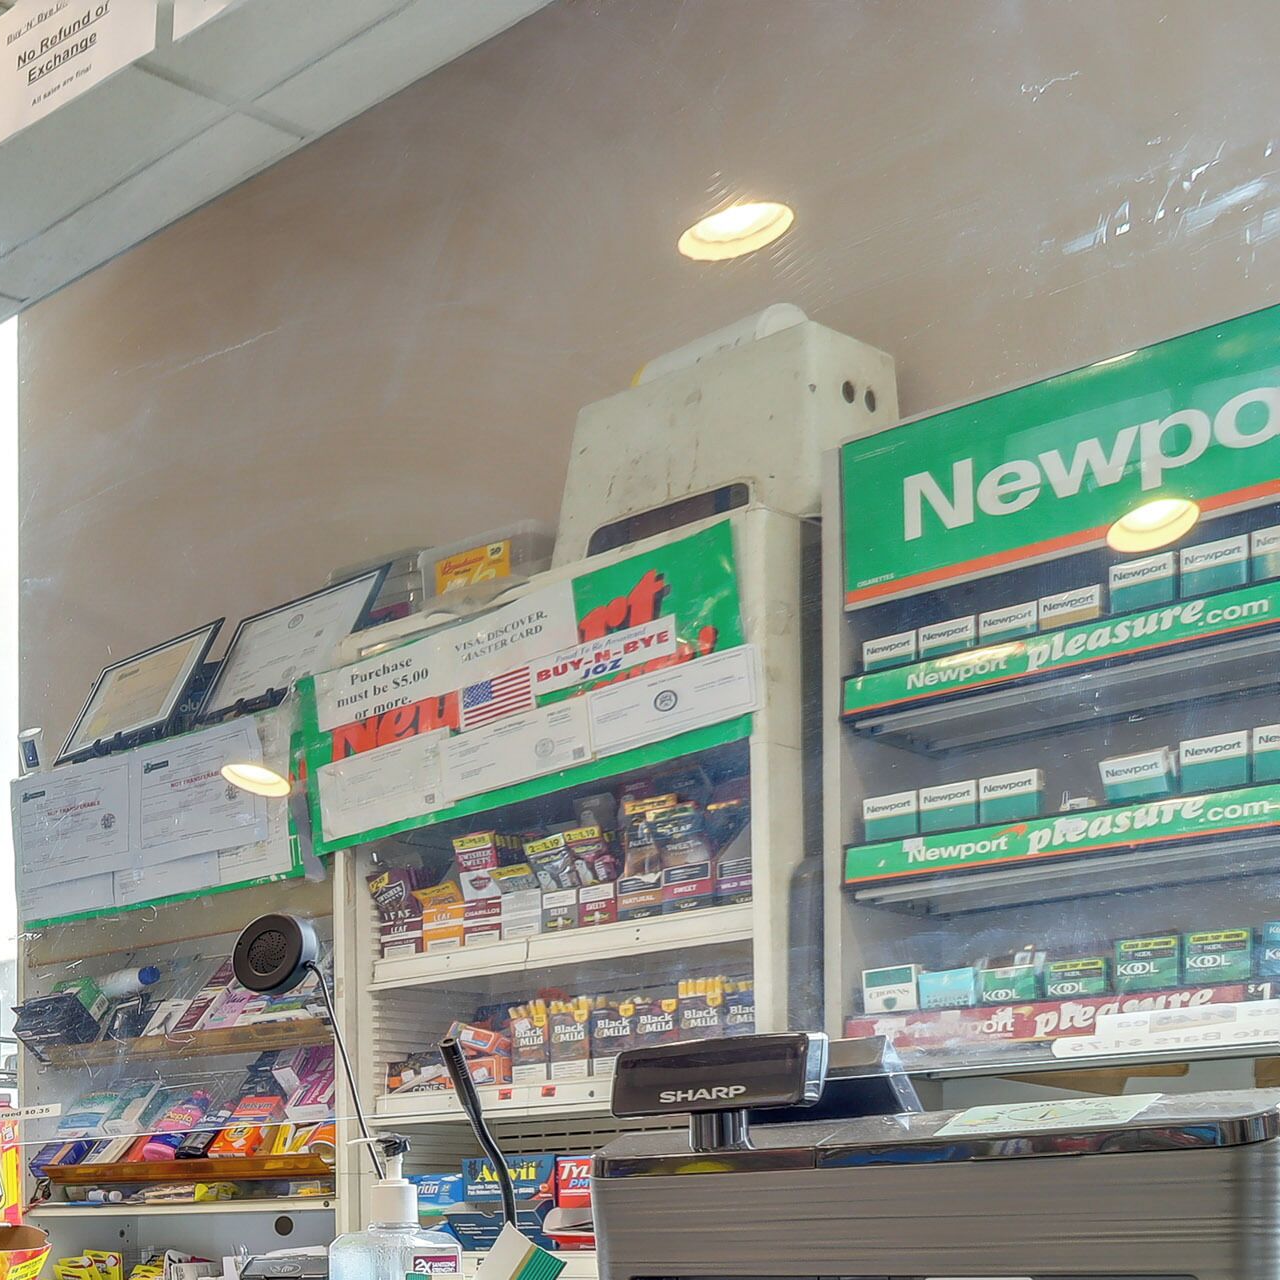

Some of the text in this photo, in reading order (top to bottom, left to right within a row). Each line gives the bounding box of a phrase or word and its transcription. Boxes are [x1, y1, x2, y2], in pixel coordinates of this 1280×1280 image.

[17, 11, 90, 68] No Refund
[28, 32, 97, 83] Exchange
[1113, 563, 1168, 583] Newport
[983, 608, 1033, 629] Newport
[461, 638, 507, 665] MASTER
[509, 624, 544, 648] CARD
[536, 630, 670, 684] BUY-N-BYE
[350, 656, 413, 686] Purchase
[582, 658, 624, 681] JOZ
[907, 656, 1008, 691] Newport
[337, 667, 429, 709] must be $5.00
[354, 695, 412, 720] or more.
[1105, 760, 1159, 779] Newport
[907, 835, 1009, 863] Newport
[1116, 962, 1159, 976] KOOL
[1186, 954, 1231, 969] KOOL
[684, 1006, 717, 1021] Black
[690, 1015, 718, 1028] Mild
[659, 1085, 746, 1104] SHARP
